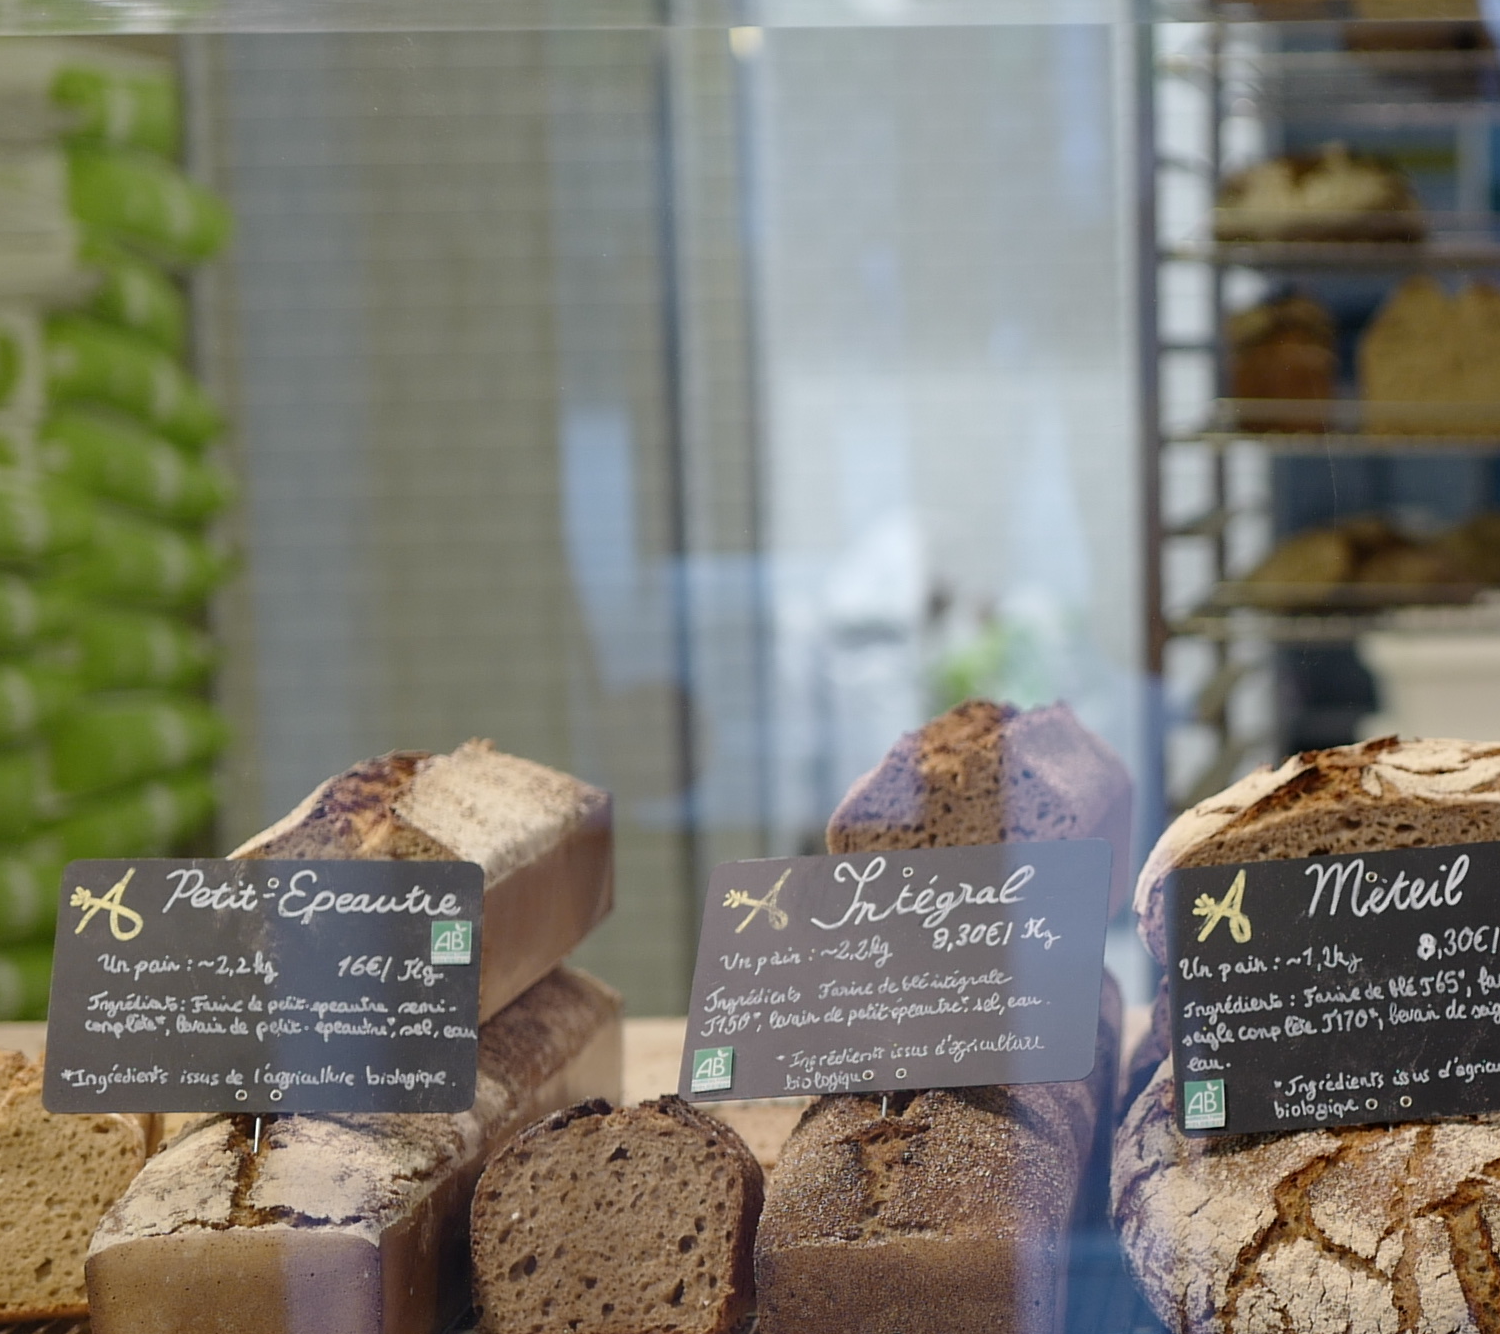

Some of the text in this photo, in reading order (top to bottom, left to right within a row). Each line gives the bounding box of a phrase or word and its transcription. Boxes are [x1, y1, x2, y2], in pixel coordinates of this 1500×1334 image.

[811, 856, 1036, 929] Intégral
[180, 1069, 222, 1085] issus
[226, 1070, 244, 1086] de
